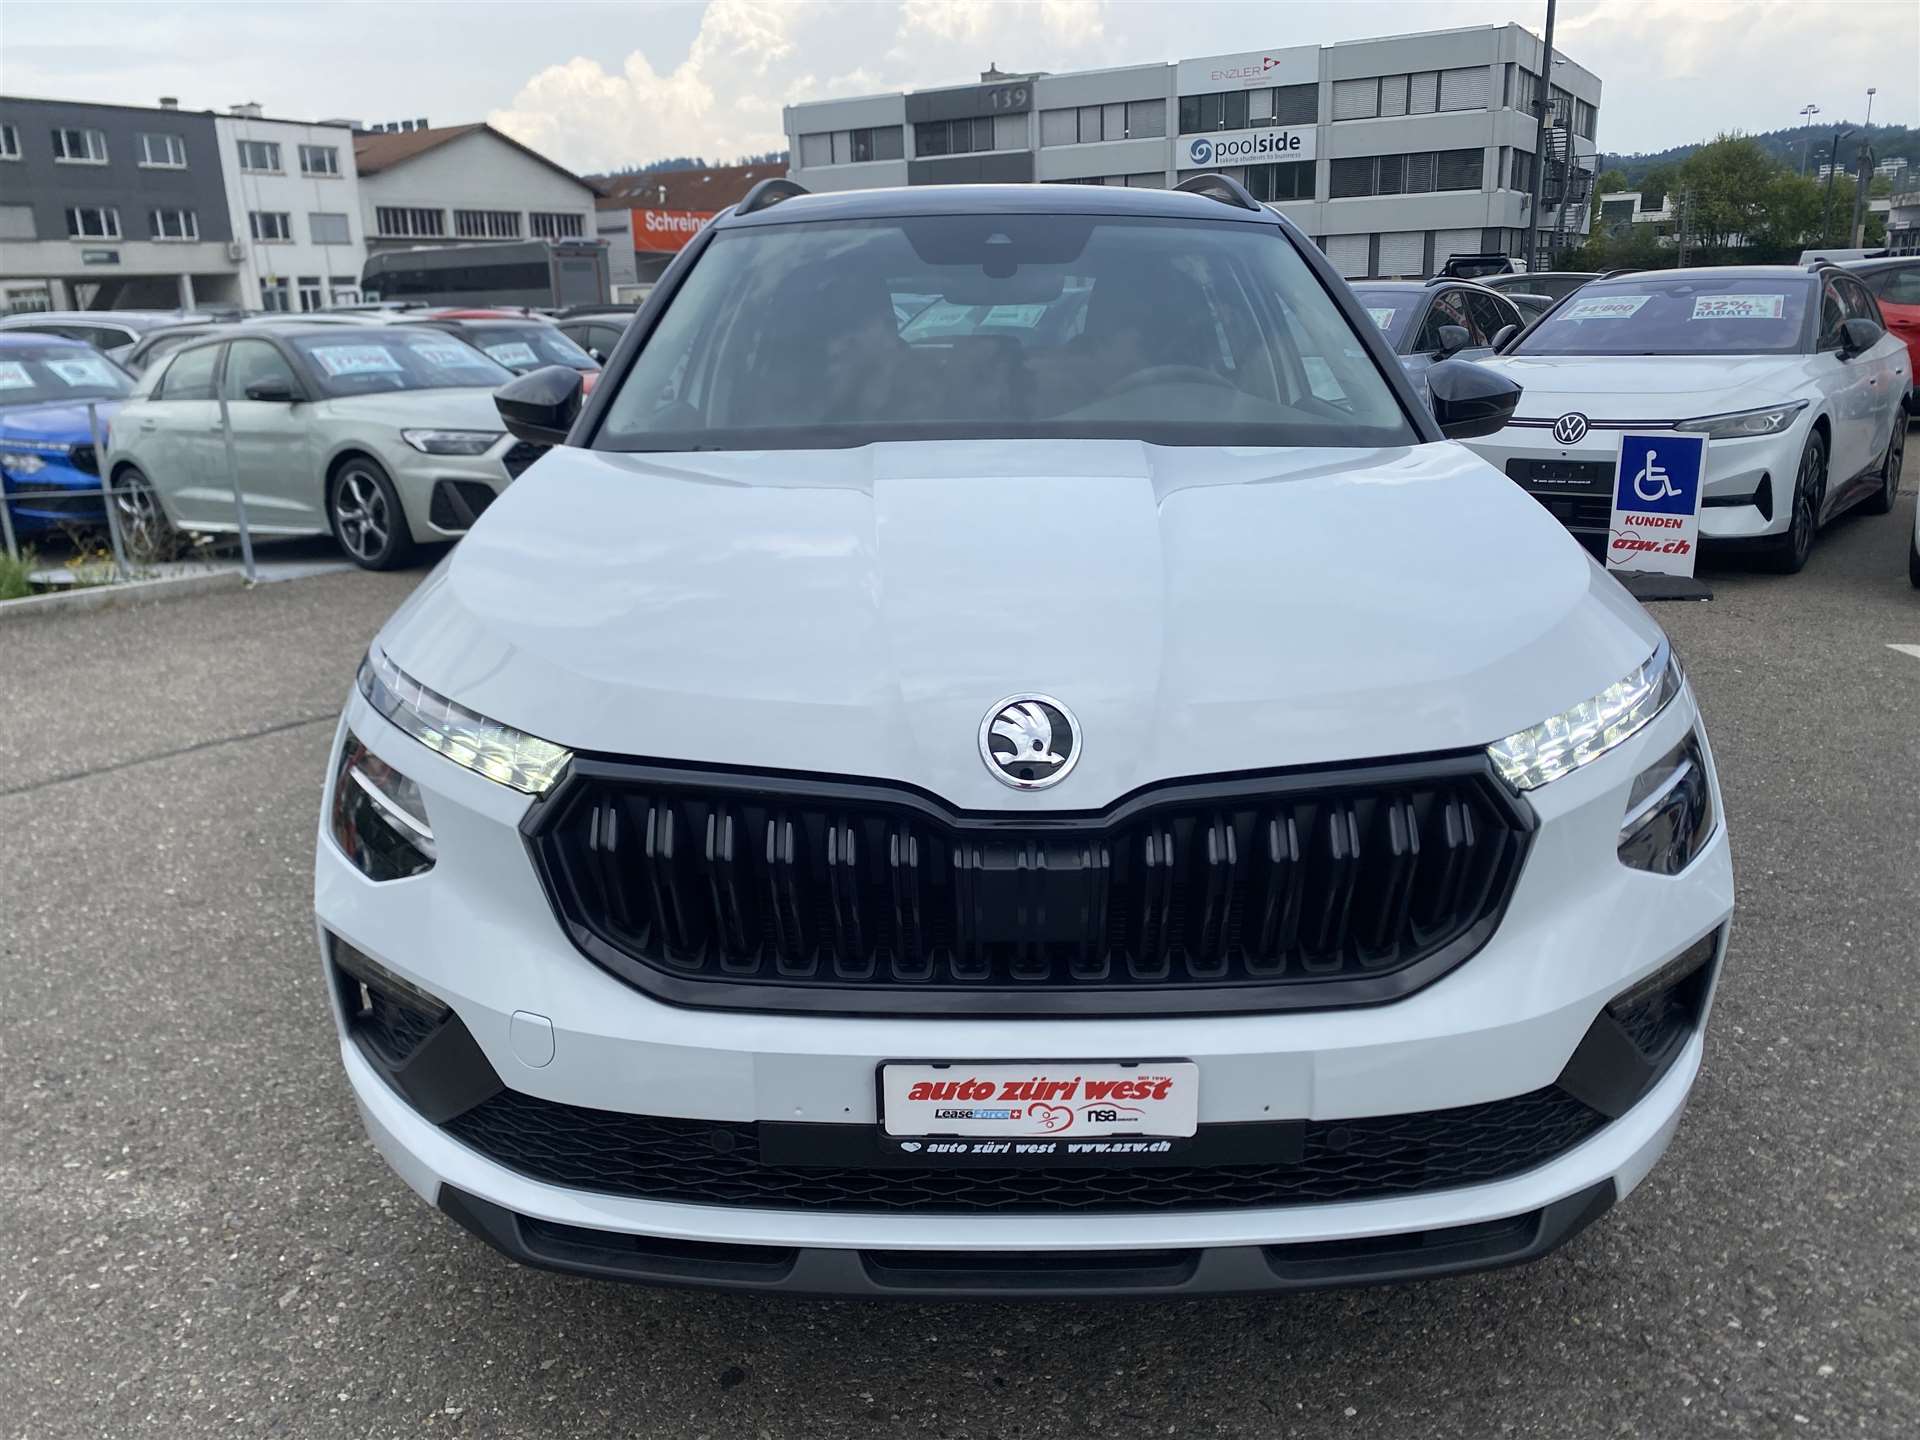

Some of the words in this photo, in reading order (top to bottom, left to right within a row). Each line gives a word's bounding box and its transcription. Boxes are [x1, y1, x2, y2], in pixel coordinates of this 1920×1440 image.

[1211, 66, 1261, 81] ENZLER
[989, 88, 1027, 109] 139
[1215, 131, 1301, 163] poolside
[1697, 301, 1753, 311] 32%
[1624, 515, 1683, 529] KUNDEN
[1612, 537, 1691, 555] azw.ch
[908, 1077, 996, 1101] auto
[996, 1077, 1081, 1101] züri
[1084, 1078, 1174, 1101] west
[934, 1109, 1009, 1120] LeaseForce
[1088, 1110, 1117, 1122] nsa
[927, 1142, 968, 1153] auto
[971, 1141, 1011, 1153] züri
[1016, 1142, 1057, 1154] west
[1067, 1141, 1172, 1153] www.azw.ch
